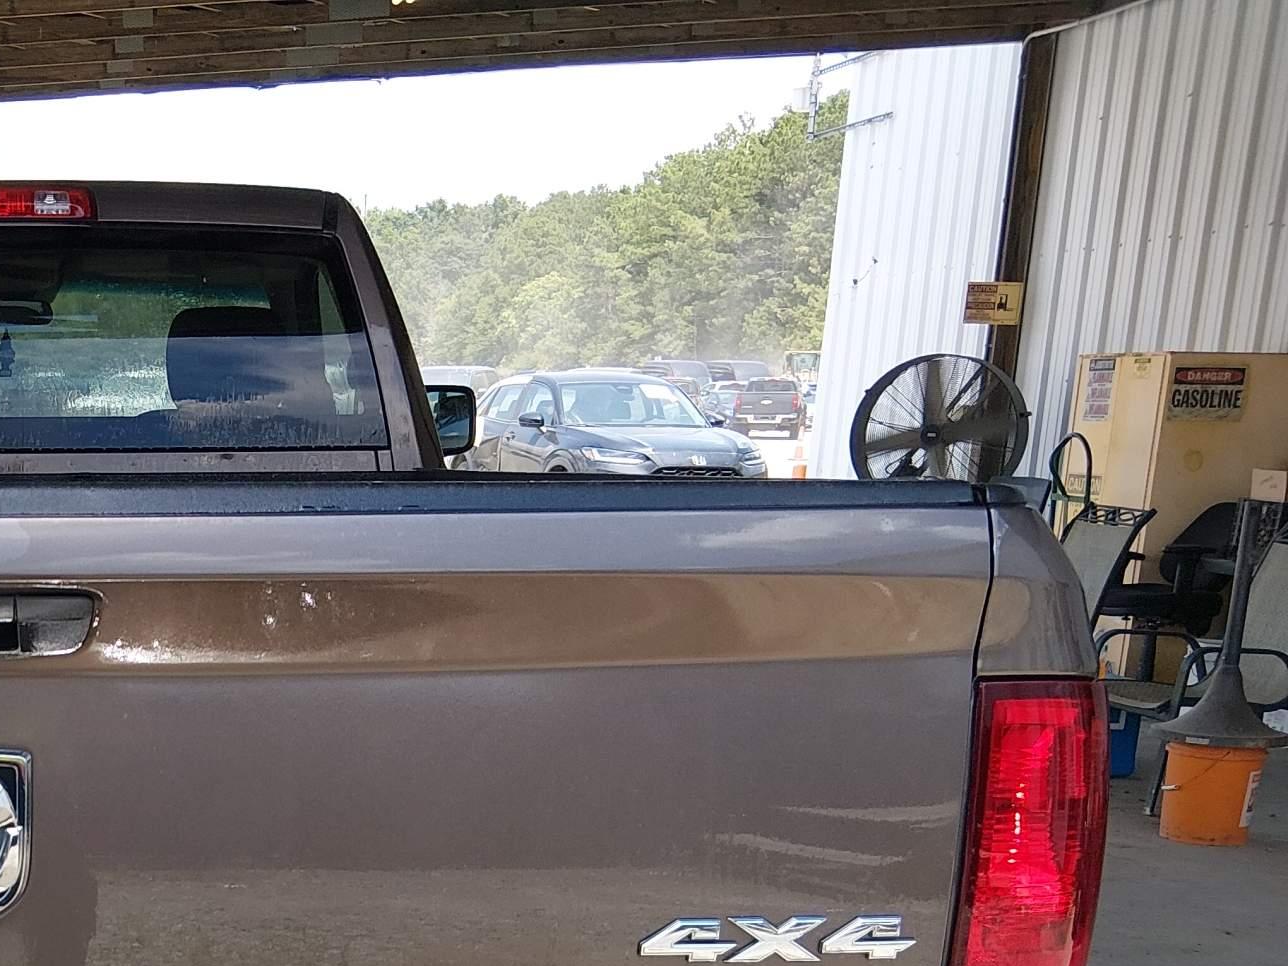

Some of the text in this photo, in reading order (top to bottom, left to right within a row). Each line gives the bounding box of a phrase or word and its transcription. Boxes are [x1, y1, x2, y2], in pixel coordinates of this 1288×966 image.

[968, 285, 997, 293] CAUTION
[1187, 371, 1232, 381] DANGER
[1172, 389, 1242, 408] GASOLINE
